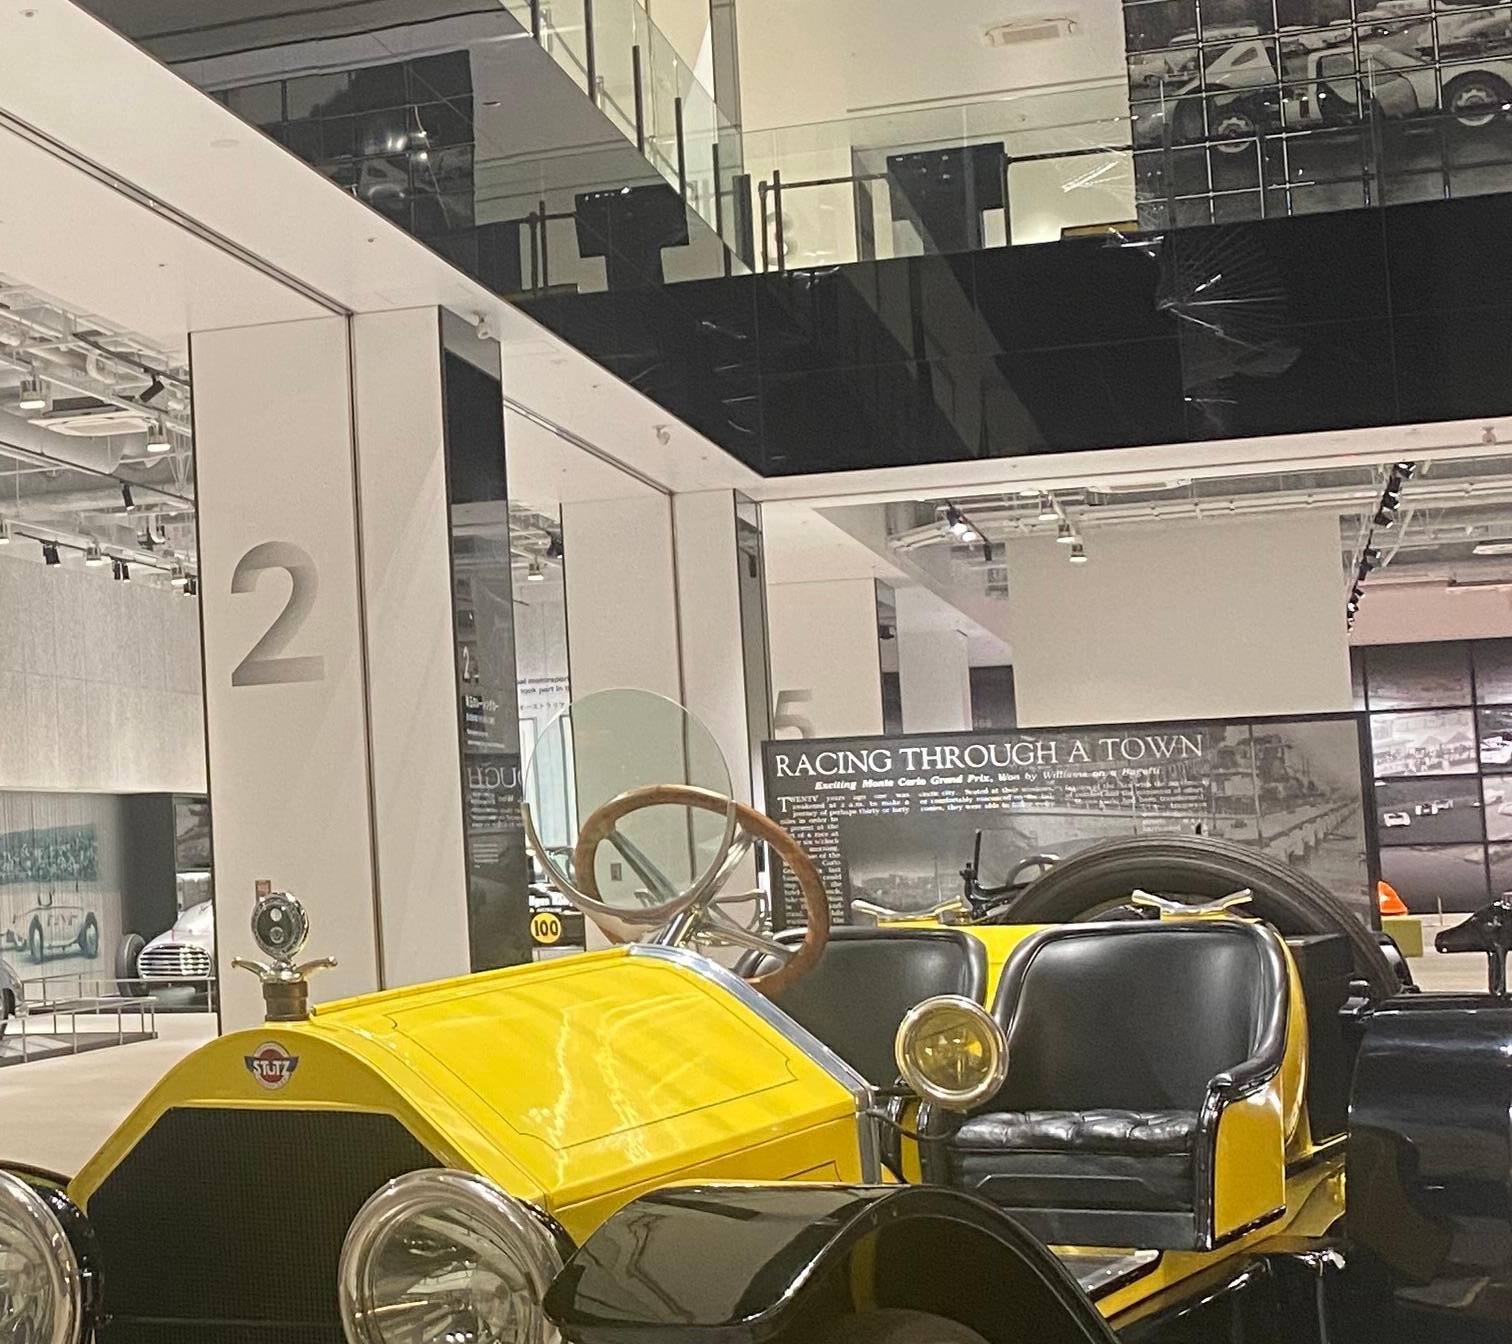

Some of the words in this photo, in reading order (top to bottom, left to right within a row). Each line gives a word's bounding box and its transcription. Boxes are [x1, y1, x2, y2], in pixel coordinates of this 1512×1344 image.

[231, 541, 324, 687] 2
[774, 689, 816, 739] 5
[776, 749, 892, 776] RACING
[899, 741, 1059, 772] THROUGH
[1069, 740, 1091, 763] A
[1099, 735, 1203, 760] TOWN
[815, 781, 857, 790] Exciting
[862, 779, 894, 788] Monte
[898, 777, 926, 787] Carlo
[930, 775, 963, 785] Grand
[998, 773, 1020, 781] Won
[1025, 772, 1037, 782] by
[1043, 770, 1088, 779] Williams
[534, 920, 558, 937] 100
[253, 1060, 290, 1076] STUTZ
